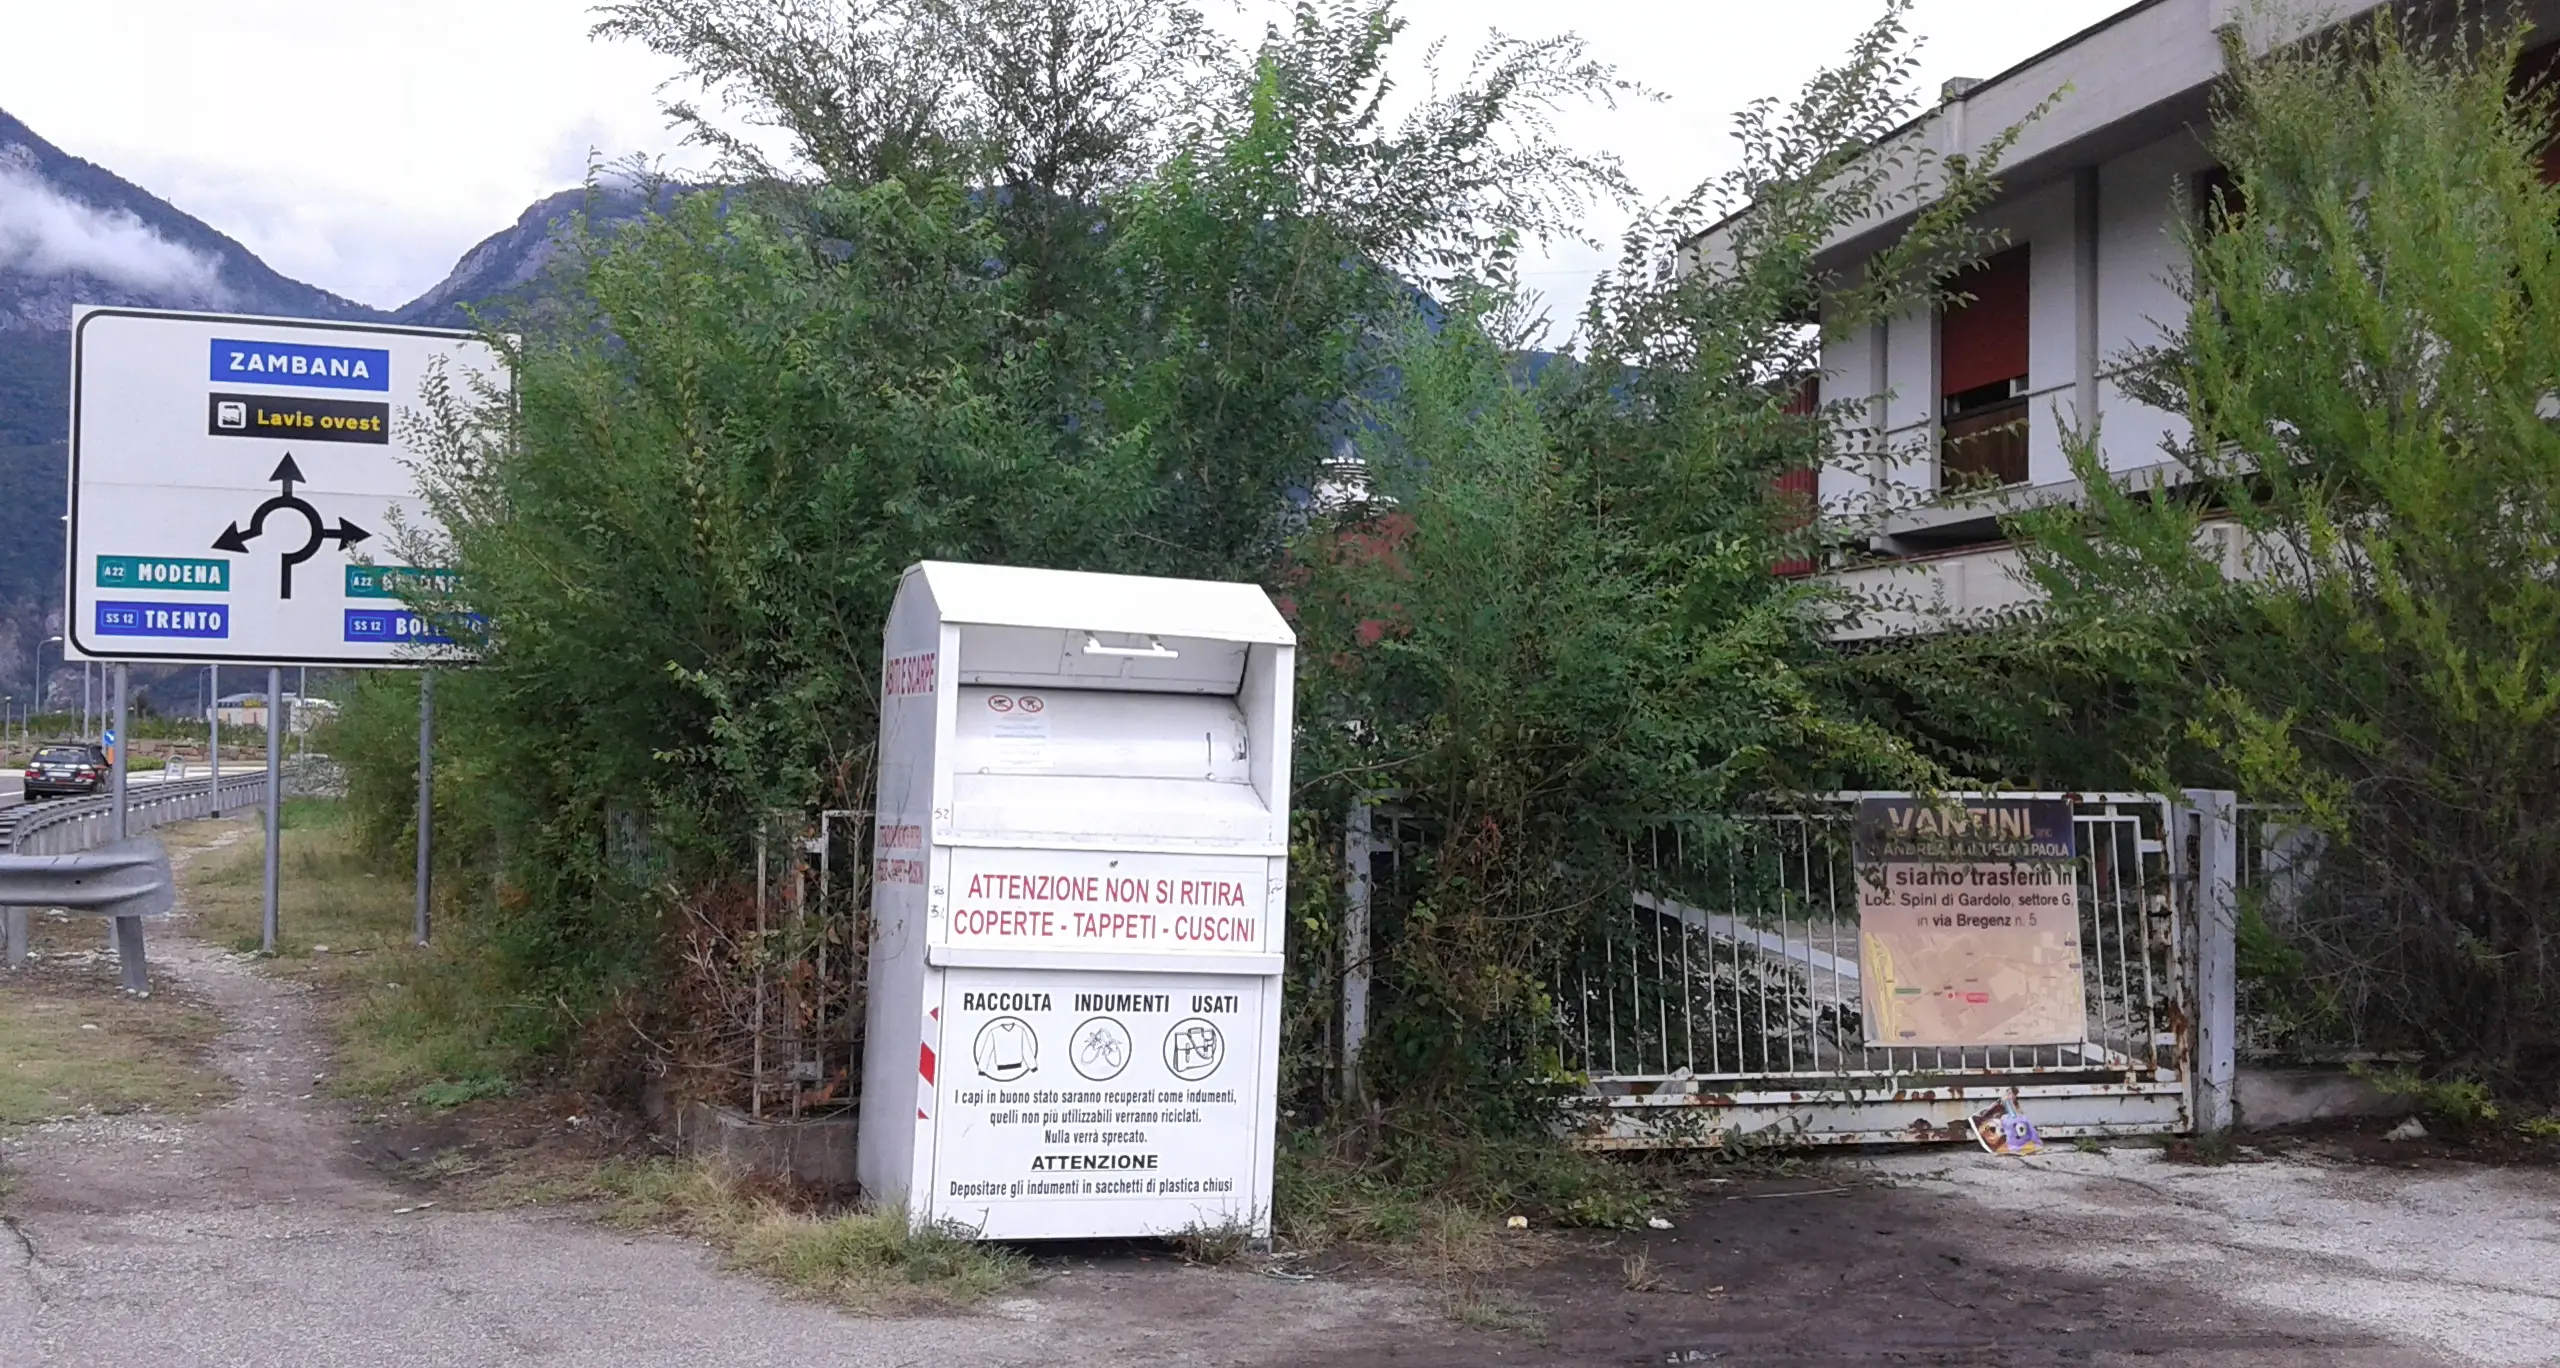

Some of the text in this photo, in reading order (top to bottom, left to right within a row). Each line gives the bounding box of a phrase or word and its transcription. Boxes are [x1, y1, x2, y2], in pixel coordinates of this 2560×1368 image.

[229, 352, 370, 379] ZAMBANA
[257, 408, 381, 432] Lavis ovest
[138, 563, 221, 584] MODENA
[105, 609, 221, 631] SS 12 TRENTO
[353, 620, 368, 631] SS
[371, 621, 381, 631] 12
[1888, 807, 2034, 838] VANTINI
[2032, 843, 2070, 857] PAOLA
[1895, 867, 1965, 886] siamo
[1971, 867, 2051, 886] trasferiti
[968, 874, 1099, 901] ATTENZIONE
[1105, 877, 1149, 904] NON
[1156, 880, 1174, 904] SI
[1180, 880, 1245, 906] RITIRA
[1865, 893, 1896, 906] Loc.
[1900, 893, 1937, 909] Spini
[1942, 893, 1954, 906] di
[1958, 892, 2014, 908] Gardolo,
[2019, 893, 2058, 906] settore
[954, 909, 1054, 936] COPERTE
[1073, 912, 1156, 939] TAPPETI
[1174, 916, 1255, 942] CUSCINI
[1917, 912, 2037, 929] in via Bregenz n. 5
[963, 992, 1238, 1013] RACCOLTA INDUMENTI USATI
[954, 1088, 1237, 1107] I capi in buono stato saranno recuperati come indumenti,
[990, 1108, 1202, 1127] quelli non più utilizzabili verranno riciclati.
[1044, 1128, 1147, 1147] Nulla verrà sprecato.
[1031, 1155, 1158, 1171] ATTENZIONE
[950, 1177, 1233, 1200] Depositare gli indumenti in sacchetti di plastica chiusi
